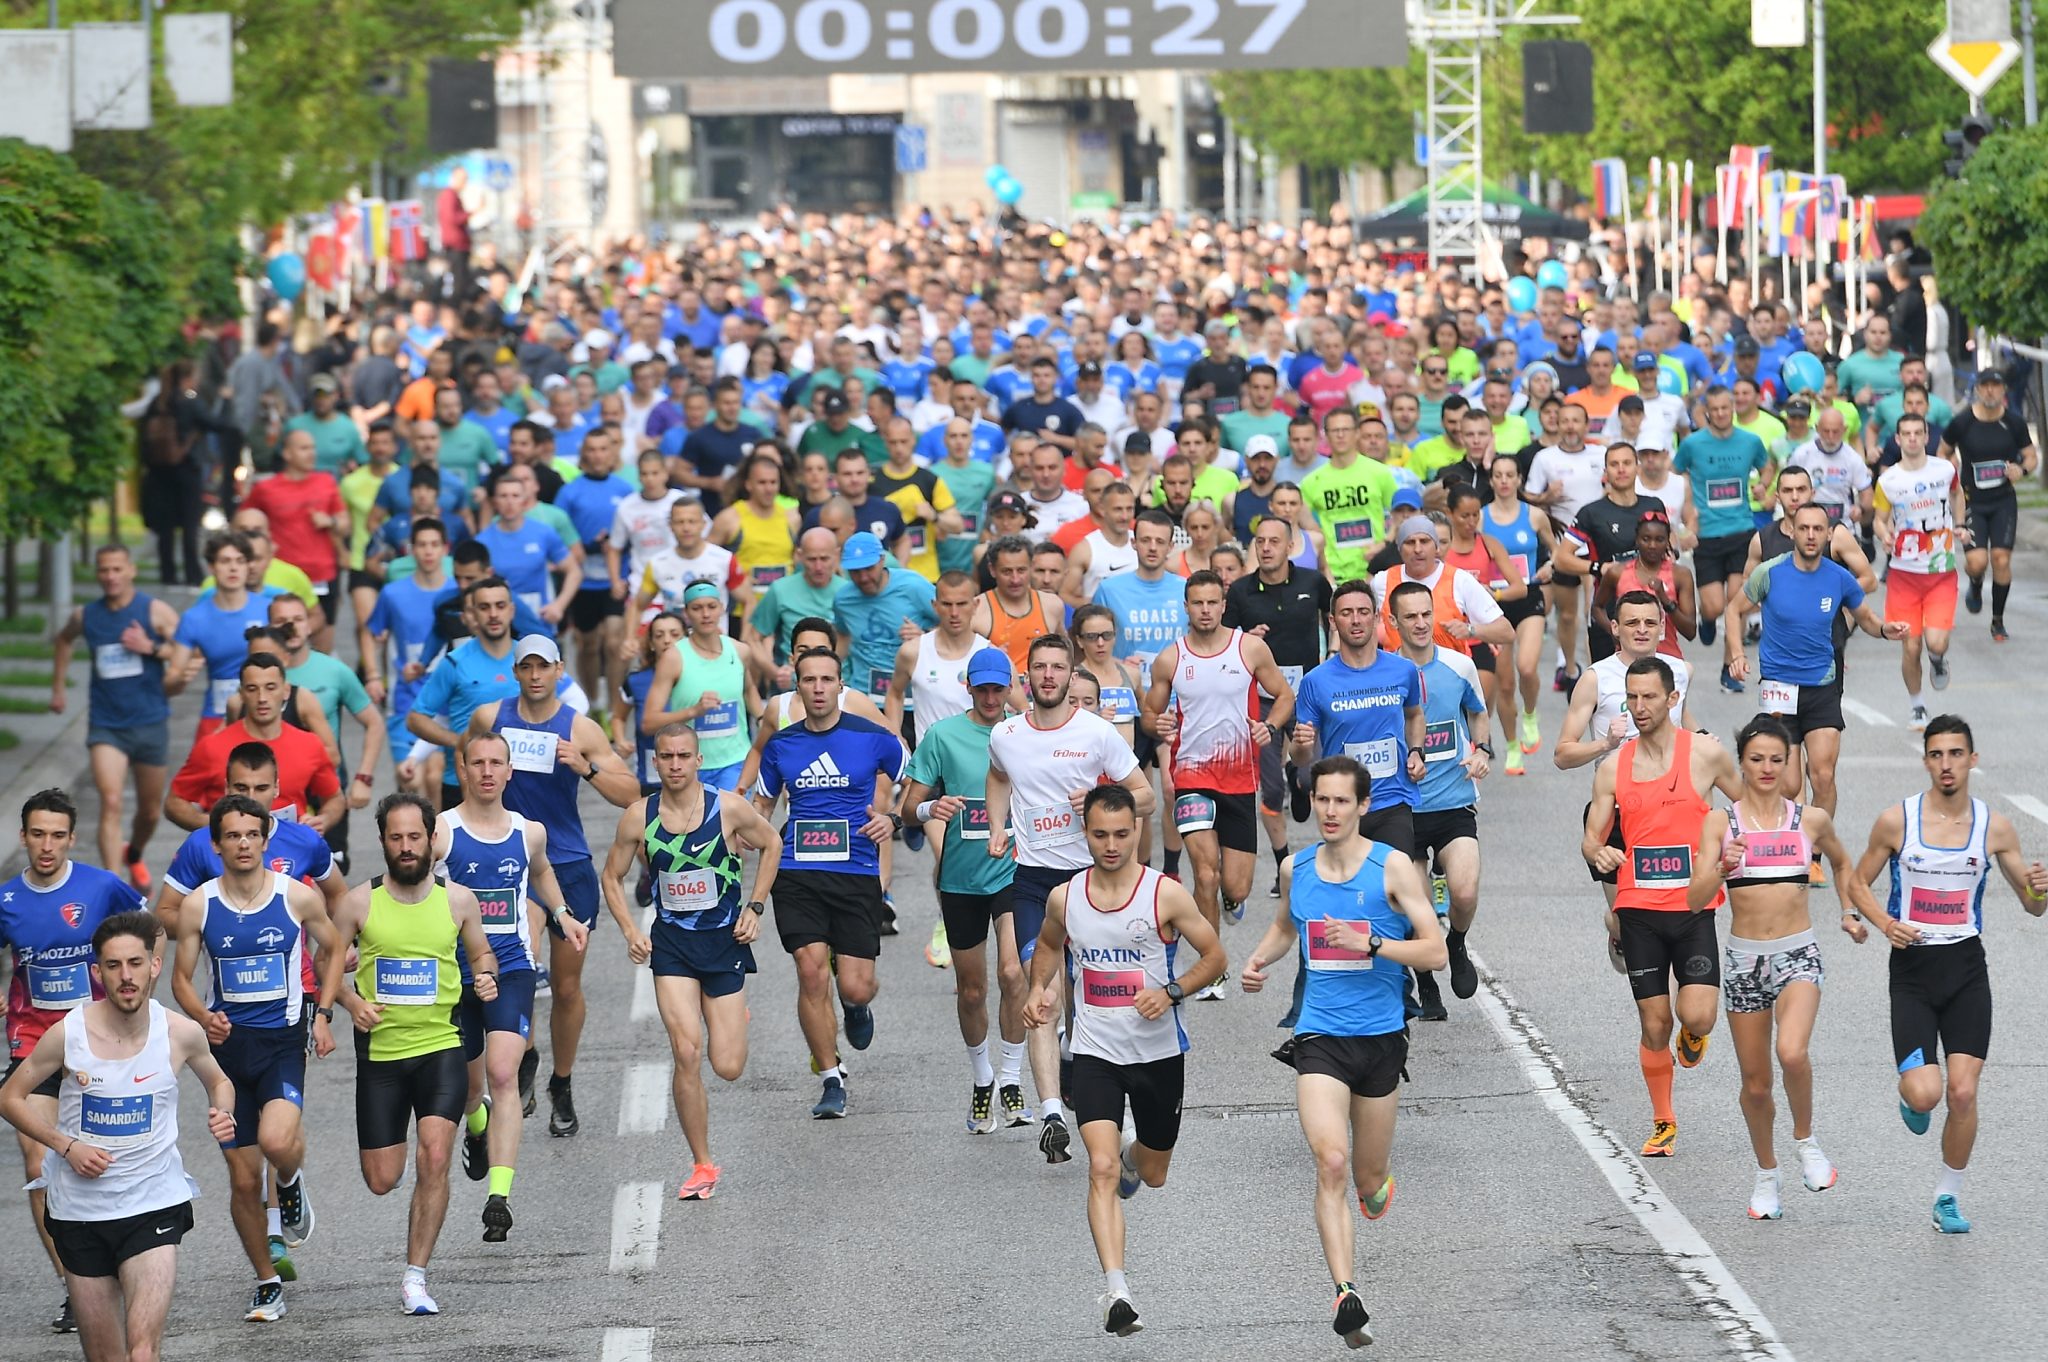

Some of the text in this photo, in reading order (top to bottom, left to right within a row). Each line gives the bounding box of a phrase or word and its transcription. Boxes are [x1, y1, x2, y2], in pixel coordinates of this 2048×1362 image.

[708, 0, 1304, 62] 00:00:27
[1129, 609, 1179, 624] GOALS
[1332, 690, 1347, 699] ALL
[1348, 686, 1384, 697] RUNNERS
[1762, 689, 1790, 702] 5116
[1330, 694, 1401, 712] CHAMPIONS
[1424, 731, 1450, 747] 377
[510, 740, 546, 757] 1048
[1355, 750, 1390, 765] 1205
[795, 774, 850, 789] adidas
[1177, 802, 1208, 819] 2322
[1033, 812, 1072, 832] 5049
[802, 831, 840, 846] 2236
[1753, 844, 1797, 858] BJELJAC
[1641, 857, 1682, 873] 2180
[667, 880, 707, 896] 5048
[480, 900, 508, 917] 302
[1913, 898, 1966, 915] IMAMOVIĆ
[37, 943, 93, 961] MOZZART
[236, 966, 269, 985] VUJIĆ
[381, 971, 433, 986] SAMARDŽIĆ
[42, 976, 75, 993] GUTIĆ
[86, 1107, 147, 1126] SAMARDŽIĆ
